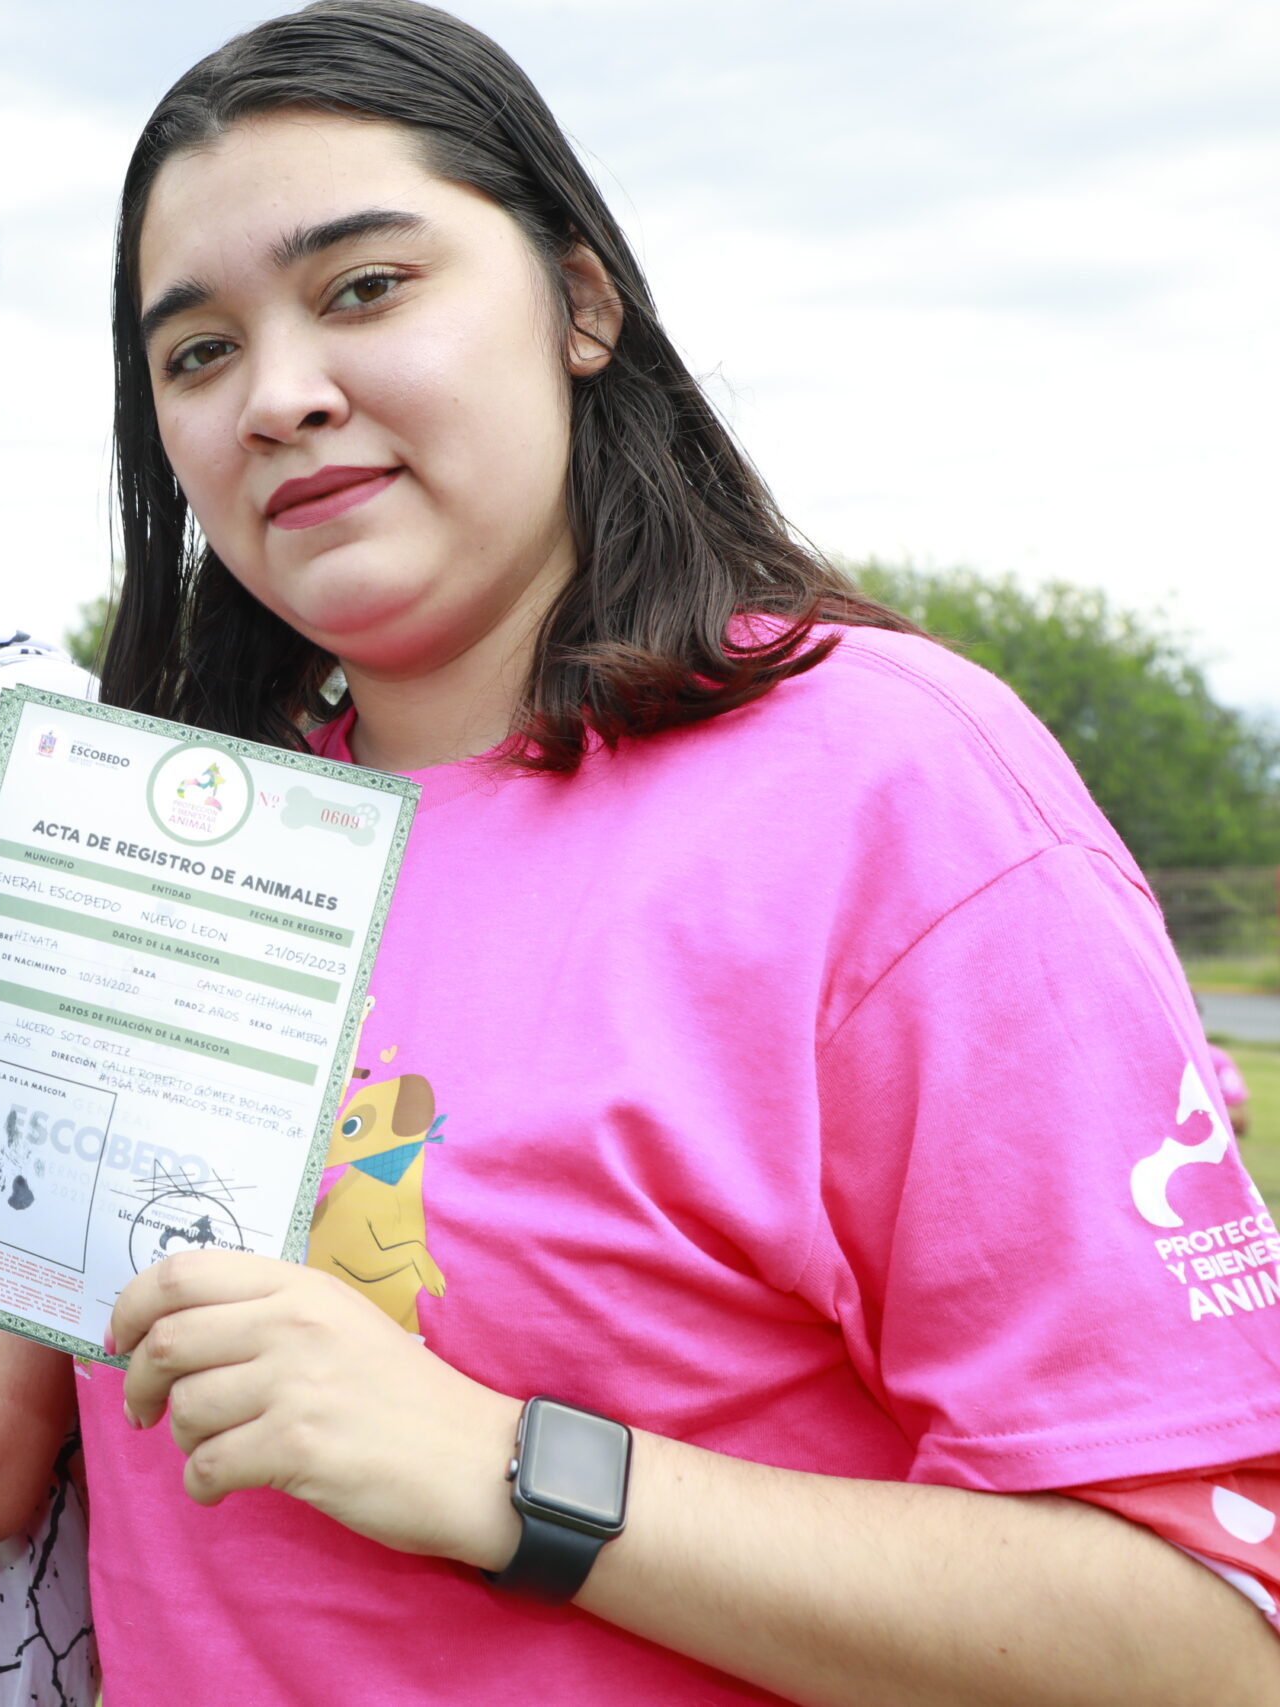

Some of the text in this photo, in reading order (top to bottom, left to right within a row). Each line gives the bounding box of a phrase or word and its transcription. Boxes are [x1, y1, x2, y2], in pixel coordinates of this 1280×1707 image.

[70, 744, 131, 768] ESCOBEDO
[168, 813, 213, 833] ANIMAL
[320, 808, 361, 830] 0609
[24, 850, 75, 870] MUNICIPIO
[32, 819, 339, 911] ACTA DE REGISTRO DE ANIMALES
[49, 884, 122, 913] ESCOBEDO
[151, 883, 192, 901] ENTIDAD
[140, 911, 187, 931] NUEVO
[249, 909, 343, 941] FECHA DE REGISTRO
[13, 929, 59, 950] HINATA
[111, 929, 221, 966] DATOS DE LA MASCOTA
[1, 951, 12, 962] DE
[14, 955, 67, 976] NACIMIENTO
[79, 971, 140, 995] 10/31/2020
[264, 943, 347, 976] 21/05/2023
[132, 967, 313, 1019] RAZA CANINO CHIHUAHUA
[15, 1016, 55, 1037] LUCERO
[60, 1029, 91, 1047] SOTO
[93, 1038, 131, 1057] ORTIZ
[58, 1002, 230, 1056] DATOS DE FILIACIÓN DE LA MASCOTA
[174, 998, 198, 1011] EDAD
[249, 1018, 273, 1032] SEXO
[280, 1025, 329, 1047] HEMBRA
[51, 1050, 97, 1069] DIRECCIÓN
[102, 1059, 136, 1076] CALLE
[138, 1067, 193, 1091] ROBERTO
[9, 1075, 19, 1085] DE
[20, 1078, 30, 1088] LA
[31, 1082, 67, 1099] MASCOTA
[137, 1082, 160, 1098] SAN
[162, 1091, 207, 1112] MARCOS
[7, 1103, 210, 1191] ESCOBEDO
[1166, 1237, 1280, 1285] Y BIENES
